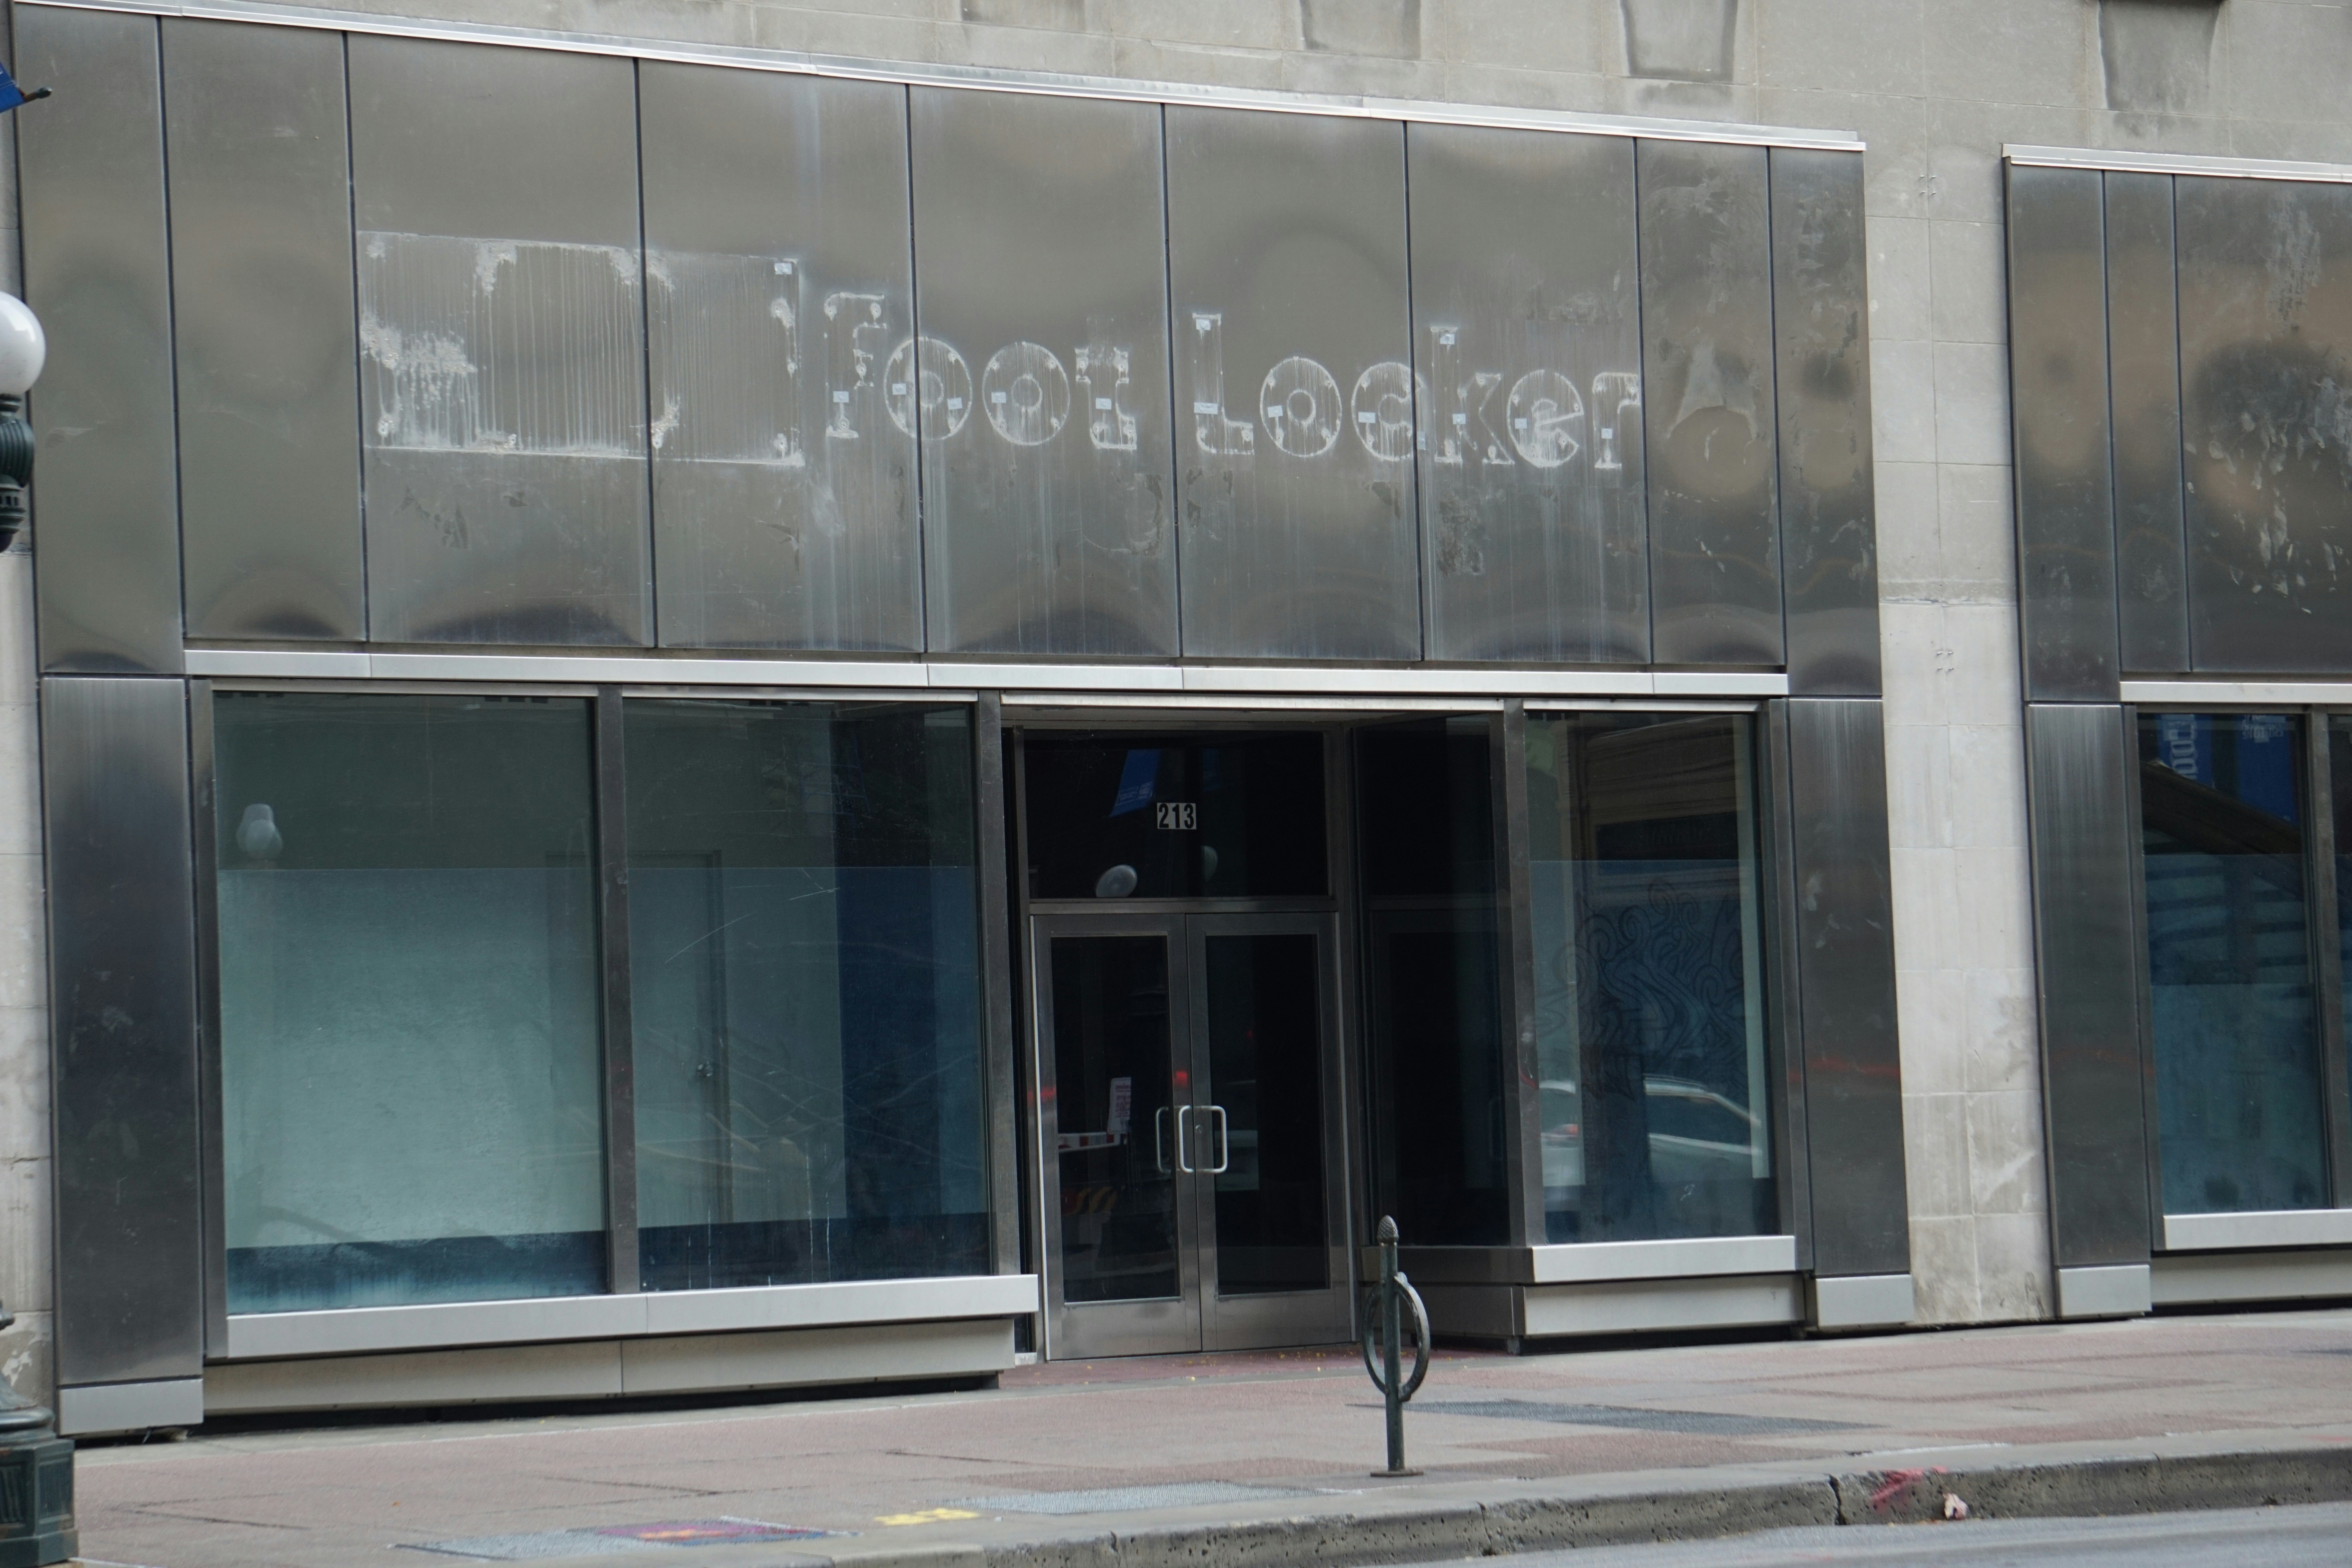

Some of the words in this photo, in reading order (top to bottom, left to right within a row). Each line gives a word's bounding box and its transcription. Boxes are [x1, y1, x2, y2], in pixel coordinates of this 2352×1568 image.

[824, 292, 1137, 450] Foot
[1192, 313, 1640, 469] Locker
[1158, 803, 1194, 829] 213
